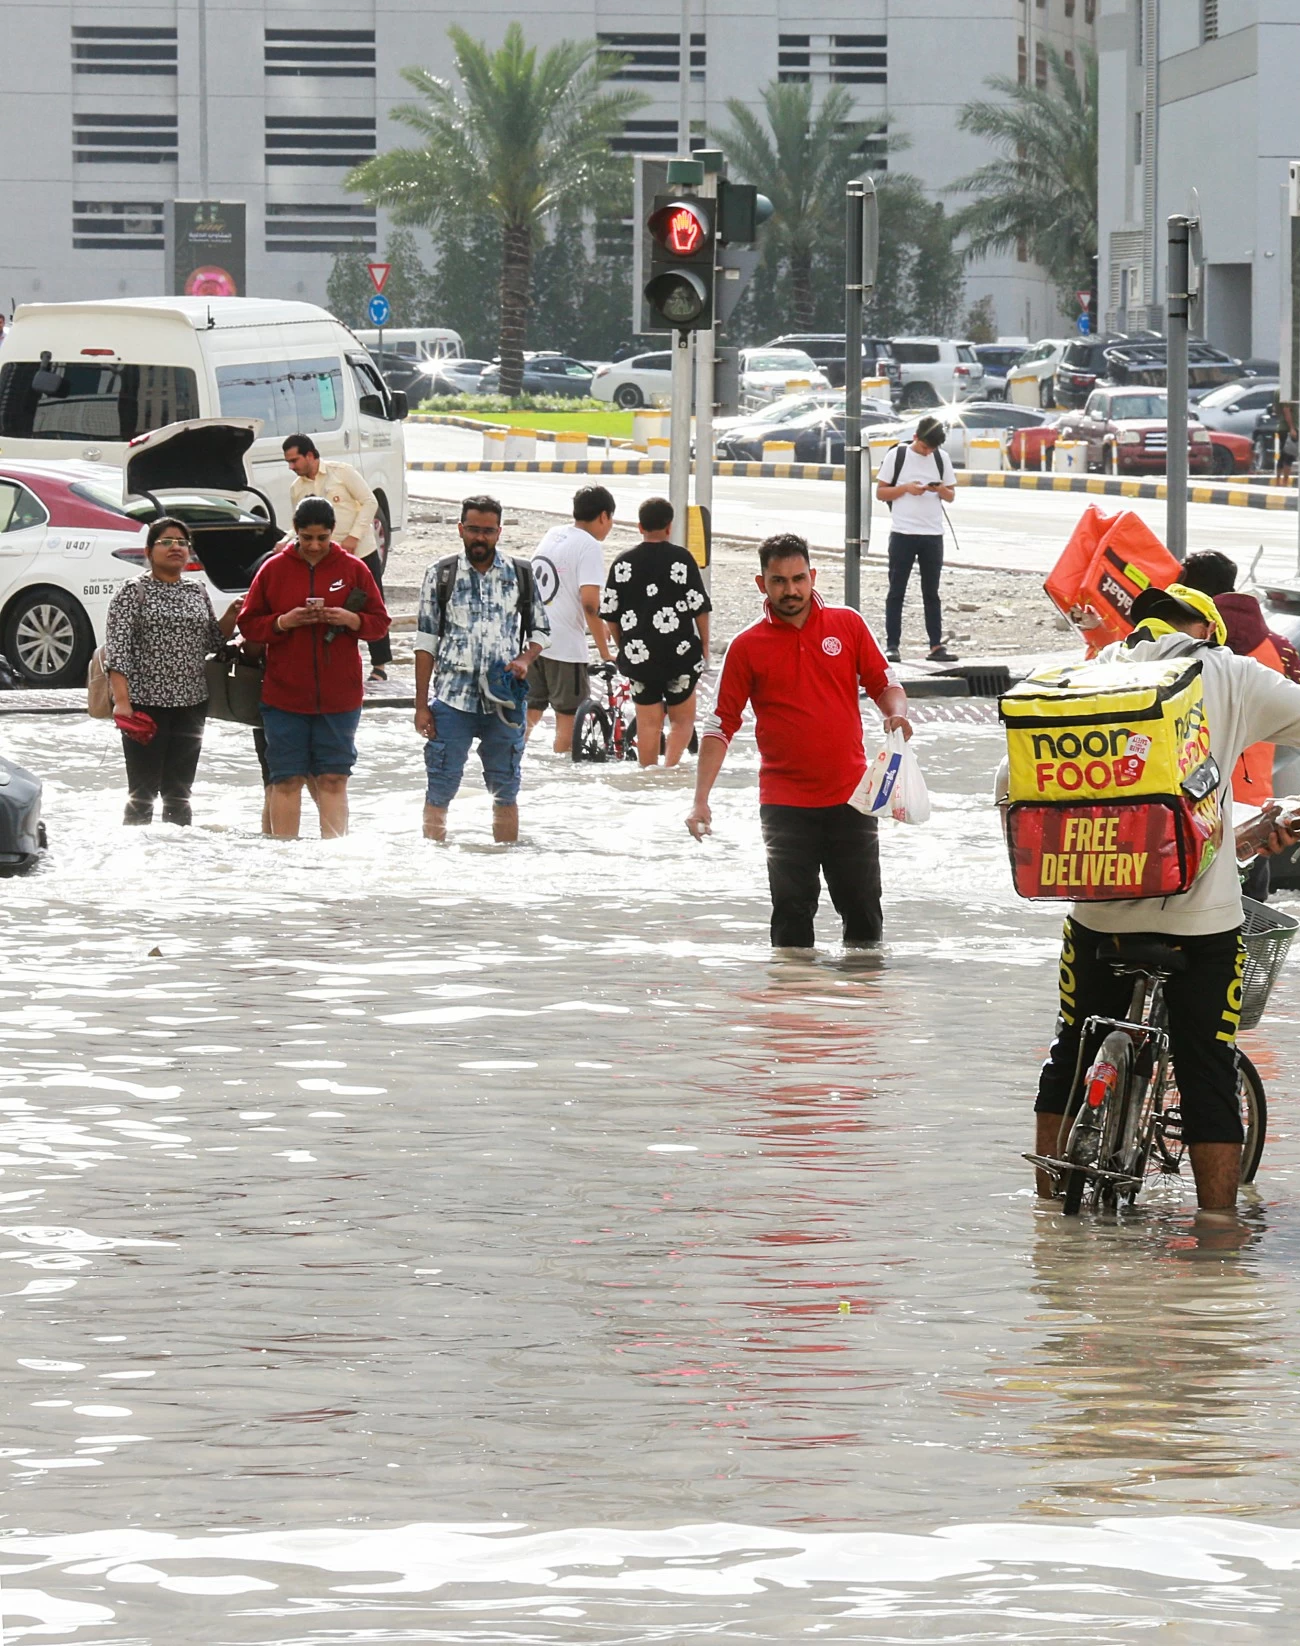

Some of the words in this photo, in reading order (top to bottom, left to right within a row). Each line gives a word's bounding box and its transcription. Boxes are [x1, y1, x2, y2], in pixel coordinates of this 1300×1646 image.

[73, 541, 91, 551] 407
[83, 585, 100, 596] 600
[102, 584, 114, 594] 52
[1063, 817, 1120, 852] FREE
[1040, 852, 1148, 886] DELIVERY
